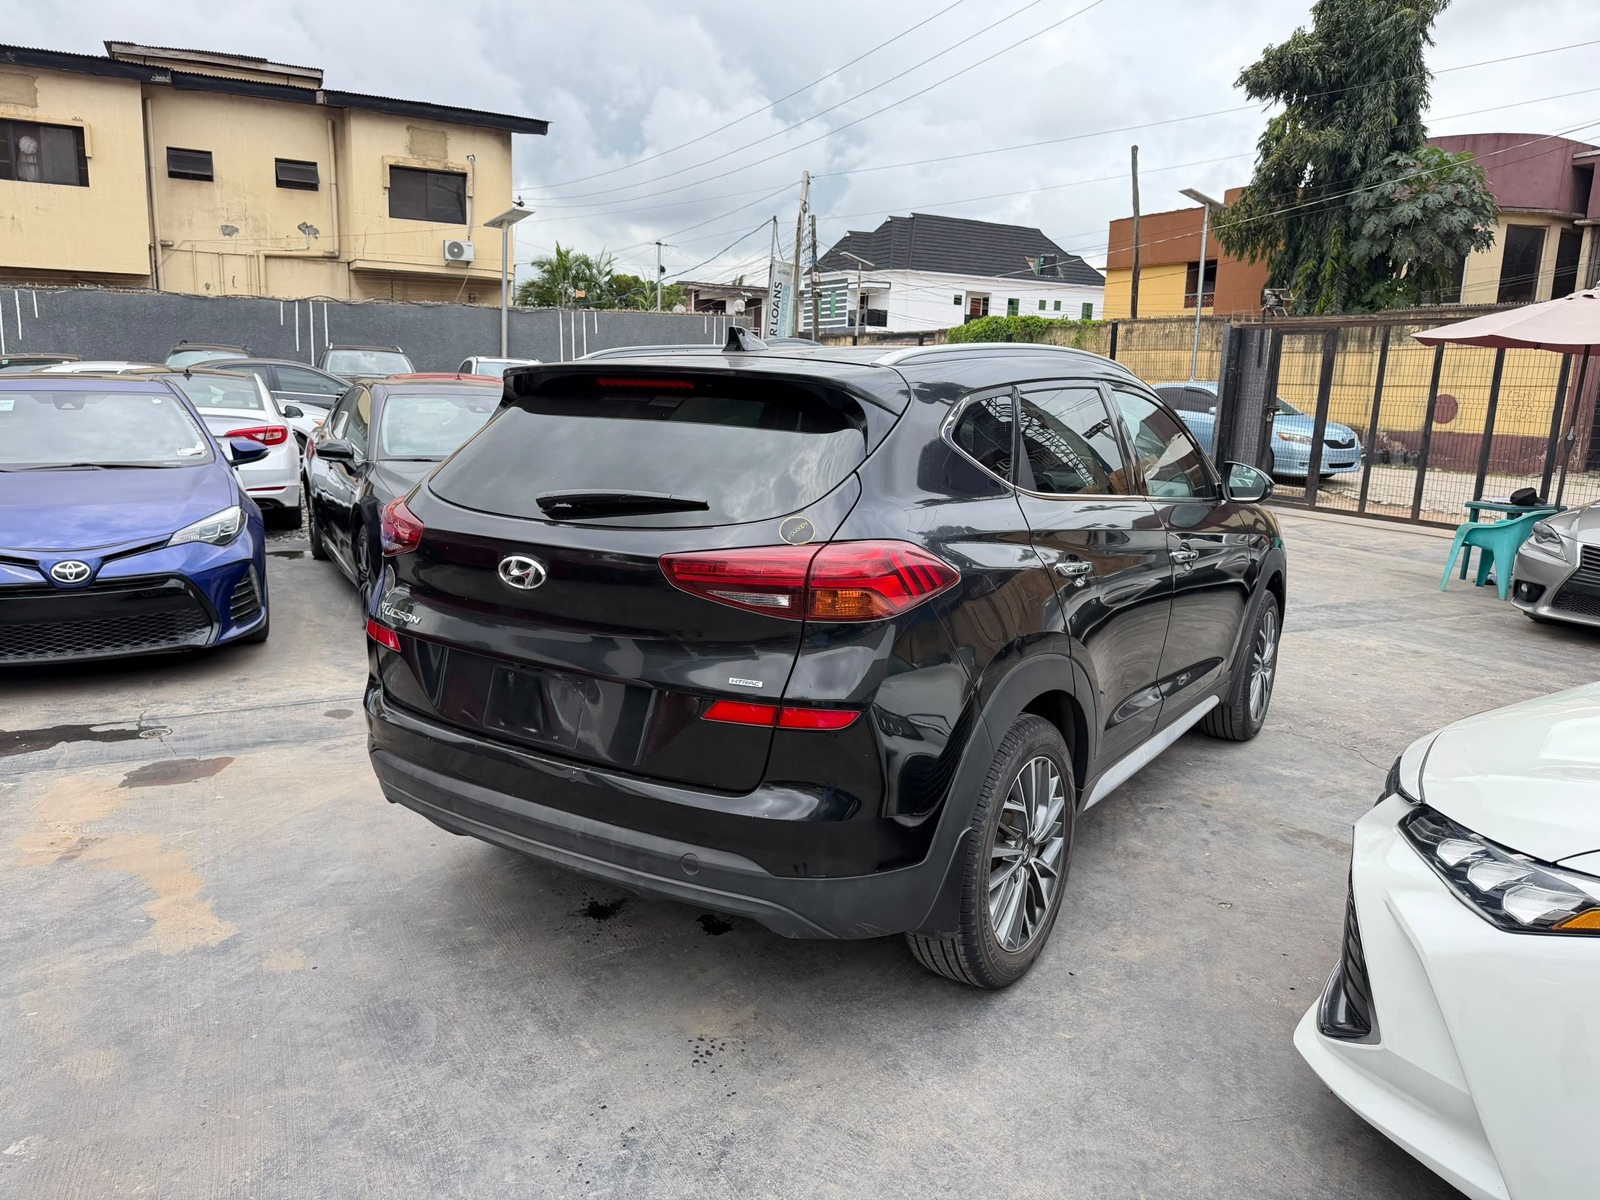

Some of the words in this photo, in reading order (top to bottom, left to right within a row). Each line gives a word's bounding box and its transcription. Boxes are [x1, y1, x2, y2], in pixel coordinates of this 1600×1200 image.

[771, 282, 782, 325] LOANS
[382, 601, 422, 624] TUCSON
[729, 678, 762, 688] HTRAC
